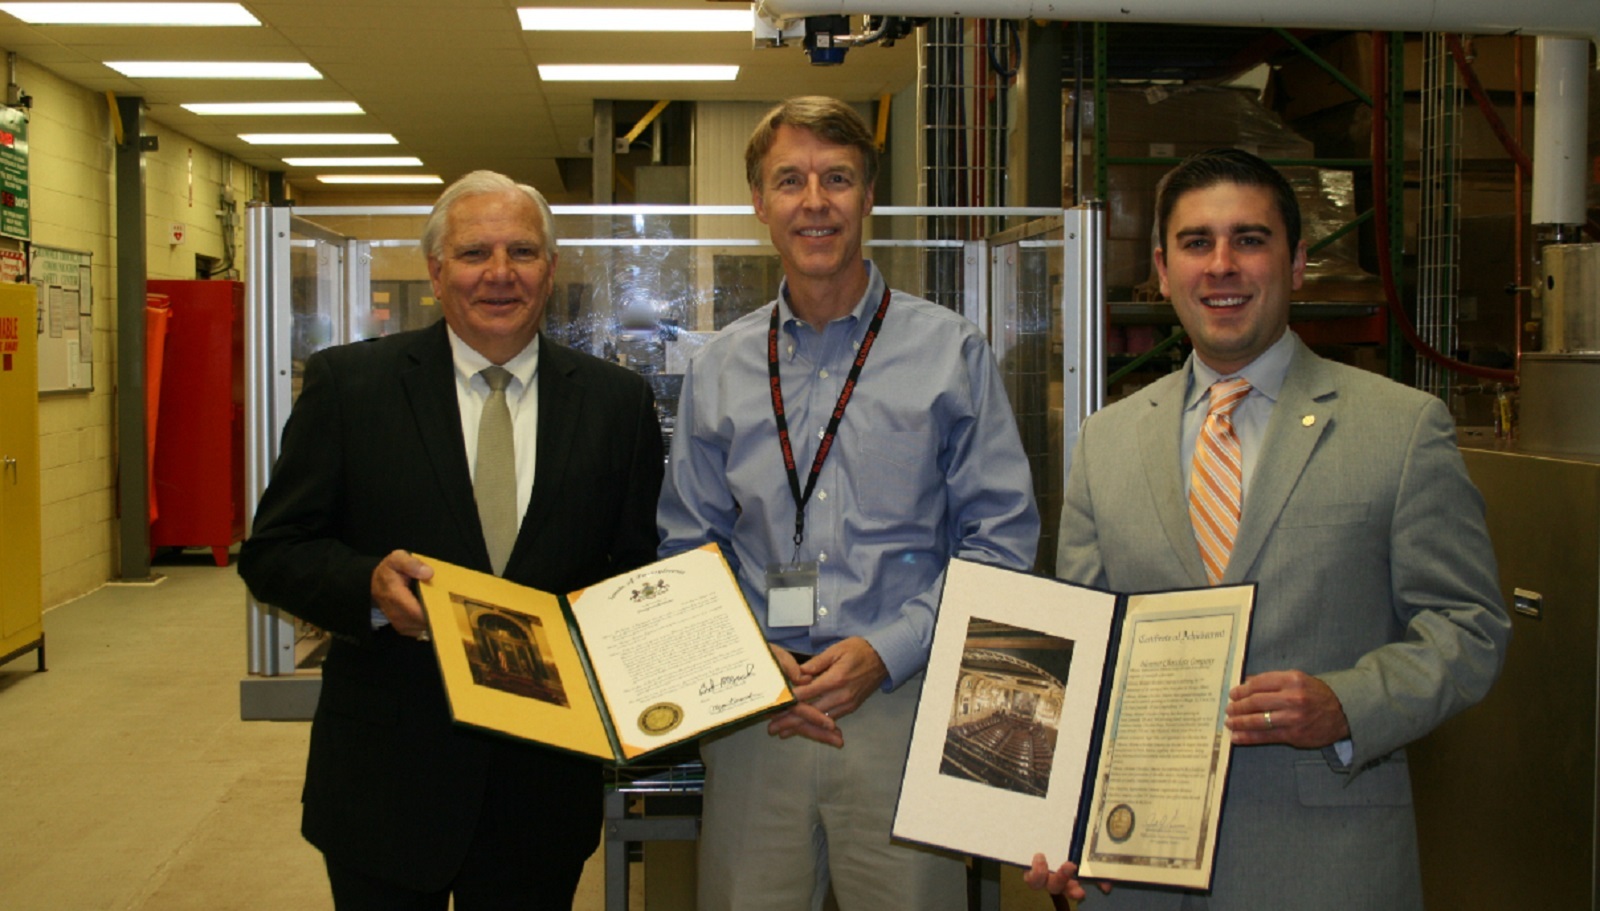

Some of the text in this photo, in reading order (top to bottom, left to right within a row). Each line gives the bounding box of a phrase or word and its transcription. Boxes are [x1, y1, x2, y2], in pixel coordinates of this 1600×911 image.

[856, 331, 876, 367] BLOMMER
[770, 377, 785, 416] BLOMMER
[834, 379, 855, 419] BLOMMER
[780, 430, 796, 470] BLOMMER
[813, 433, 833, 473] BLOMMER
